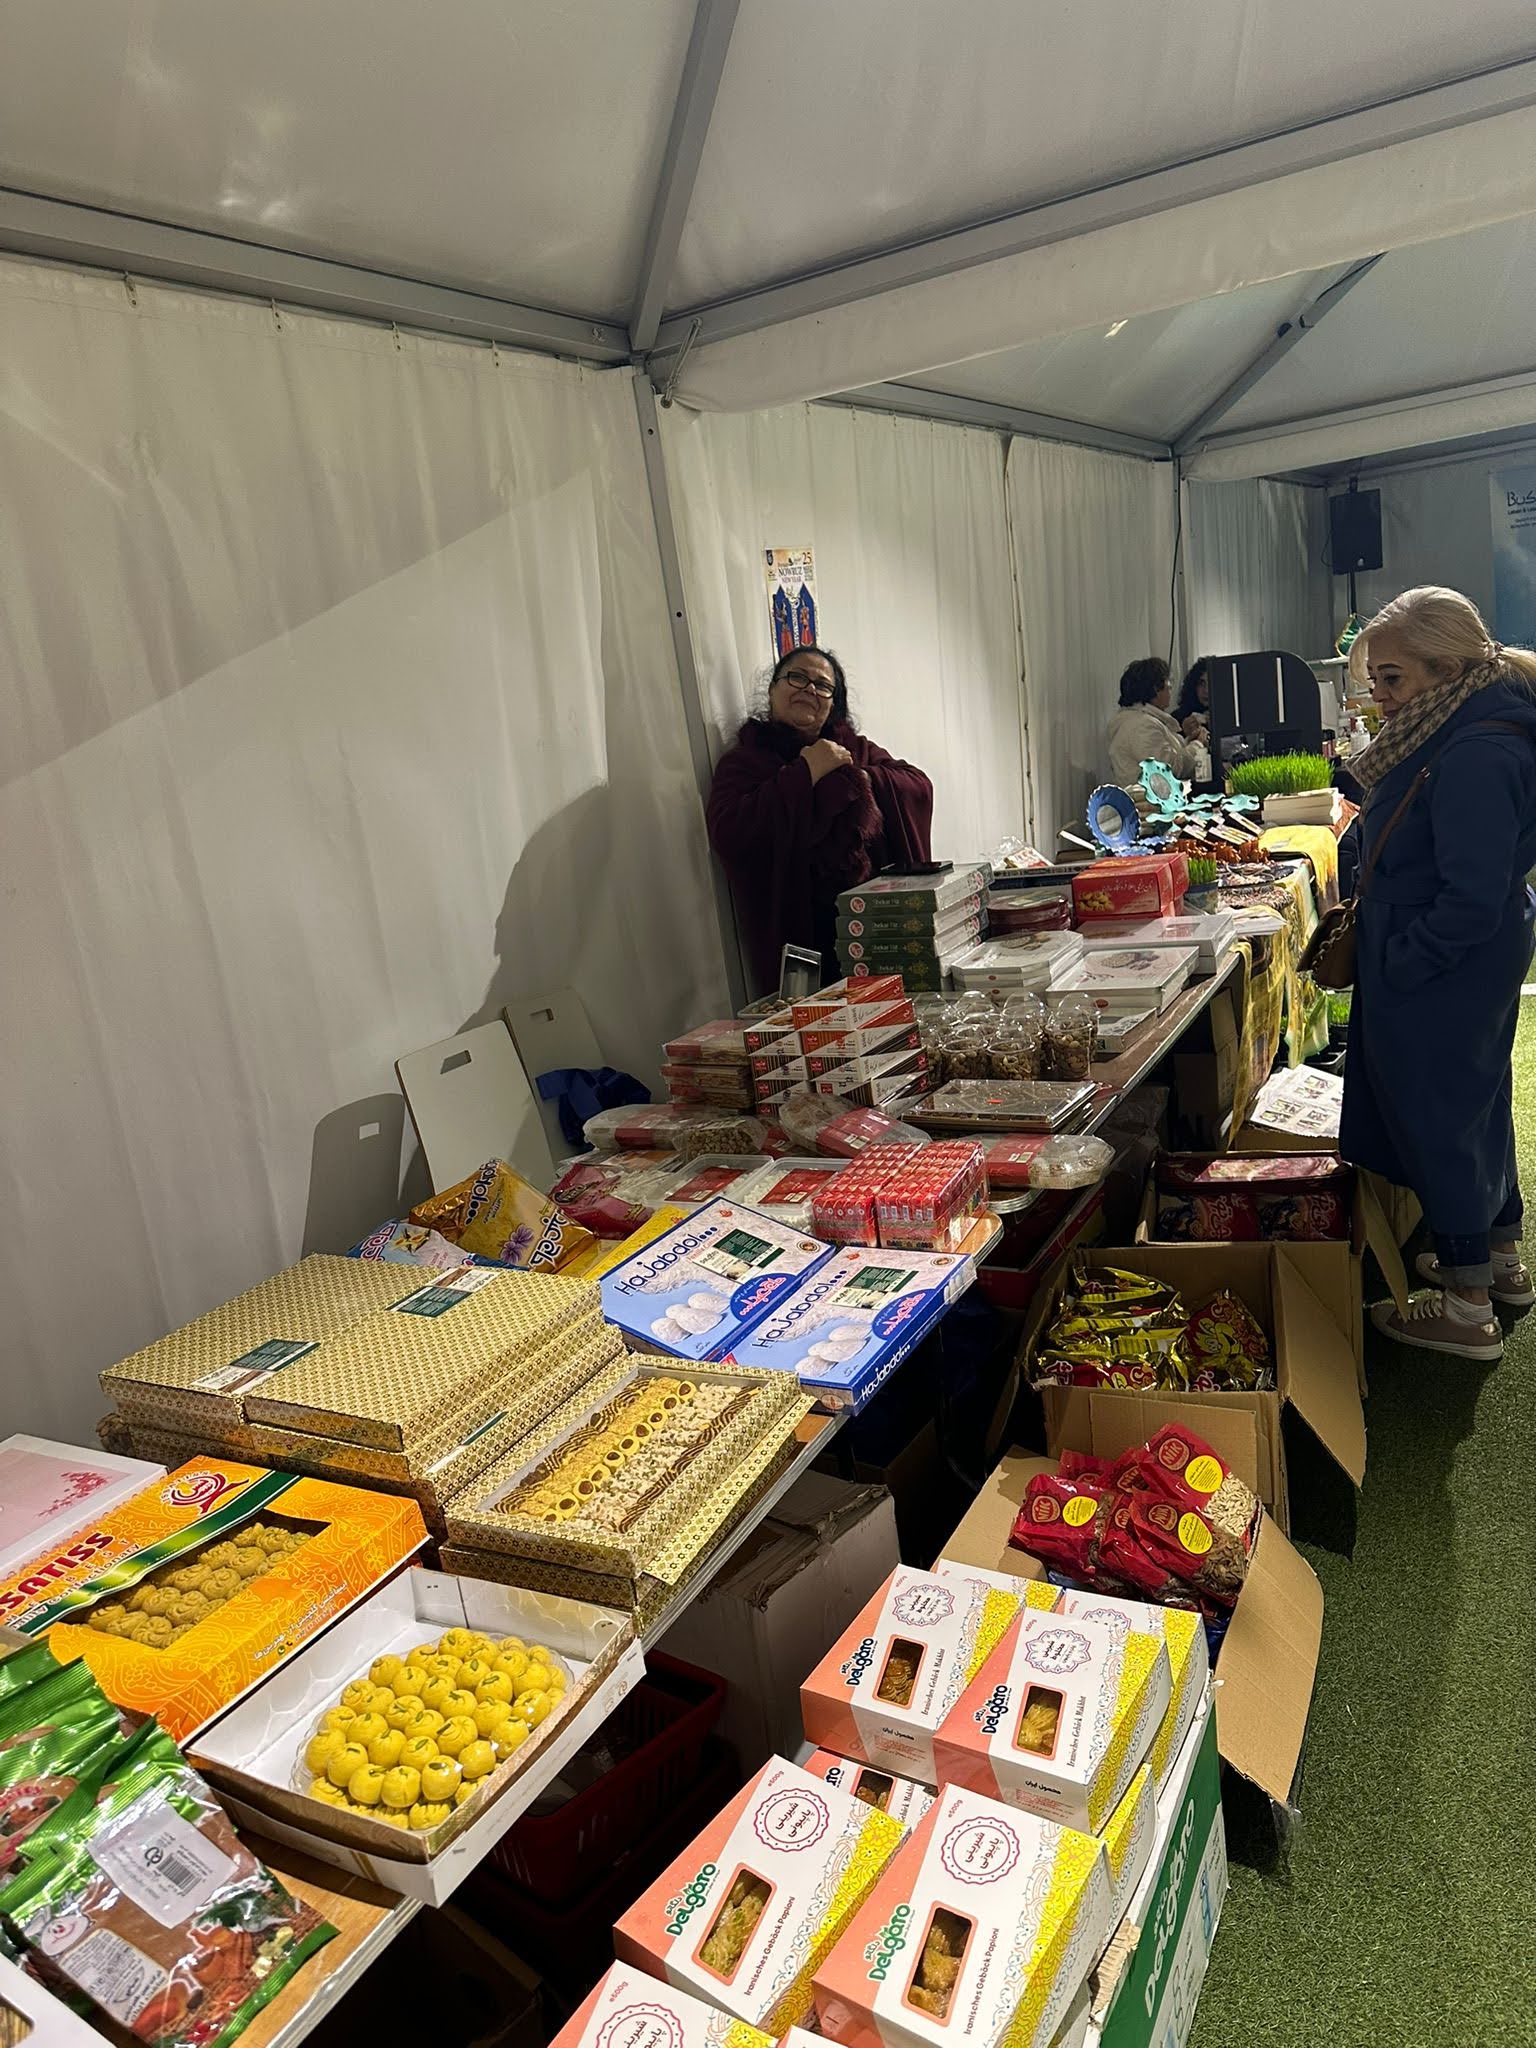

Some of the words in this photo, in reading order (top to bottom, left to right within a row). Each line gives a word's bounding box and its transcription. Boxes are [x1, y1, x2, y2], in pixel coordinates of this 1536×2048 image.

[0, 1532, 114, 1617] SATISS
[745, 1956, 768, 1996] Iranisches
[764, 1924, 780, 1954] Gebäck
[779, 1896, 795, 1925] Papioni
[964, 1989, 982, 2035] Iranisches
[977, 1958, 991, 1990] Gebäck
[986, 1928, 1000, 1958] Papioni
